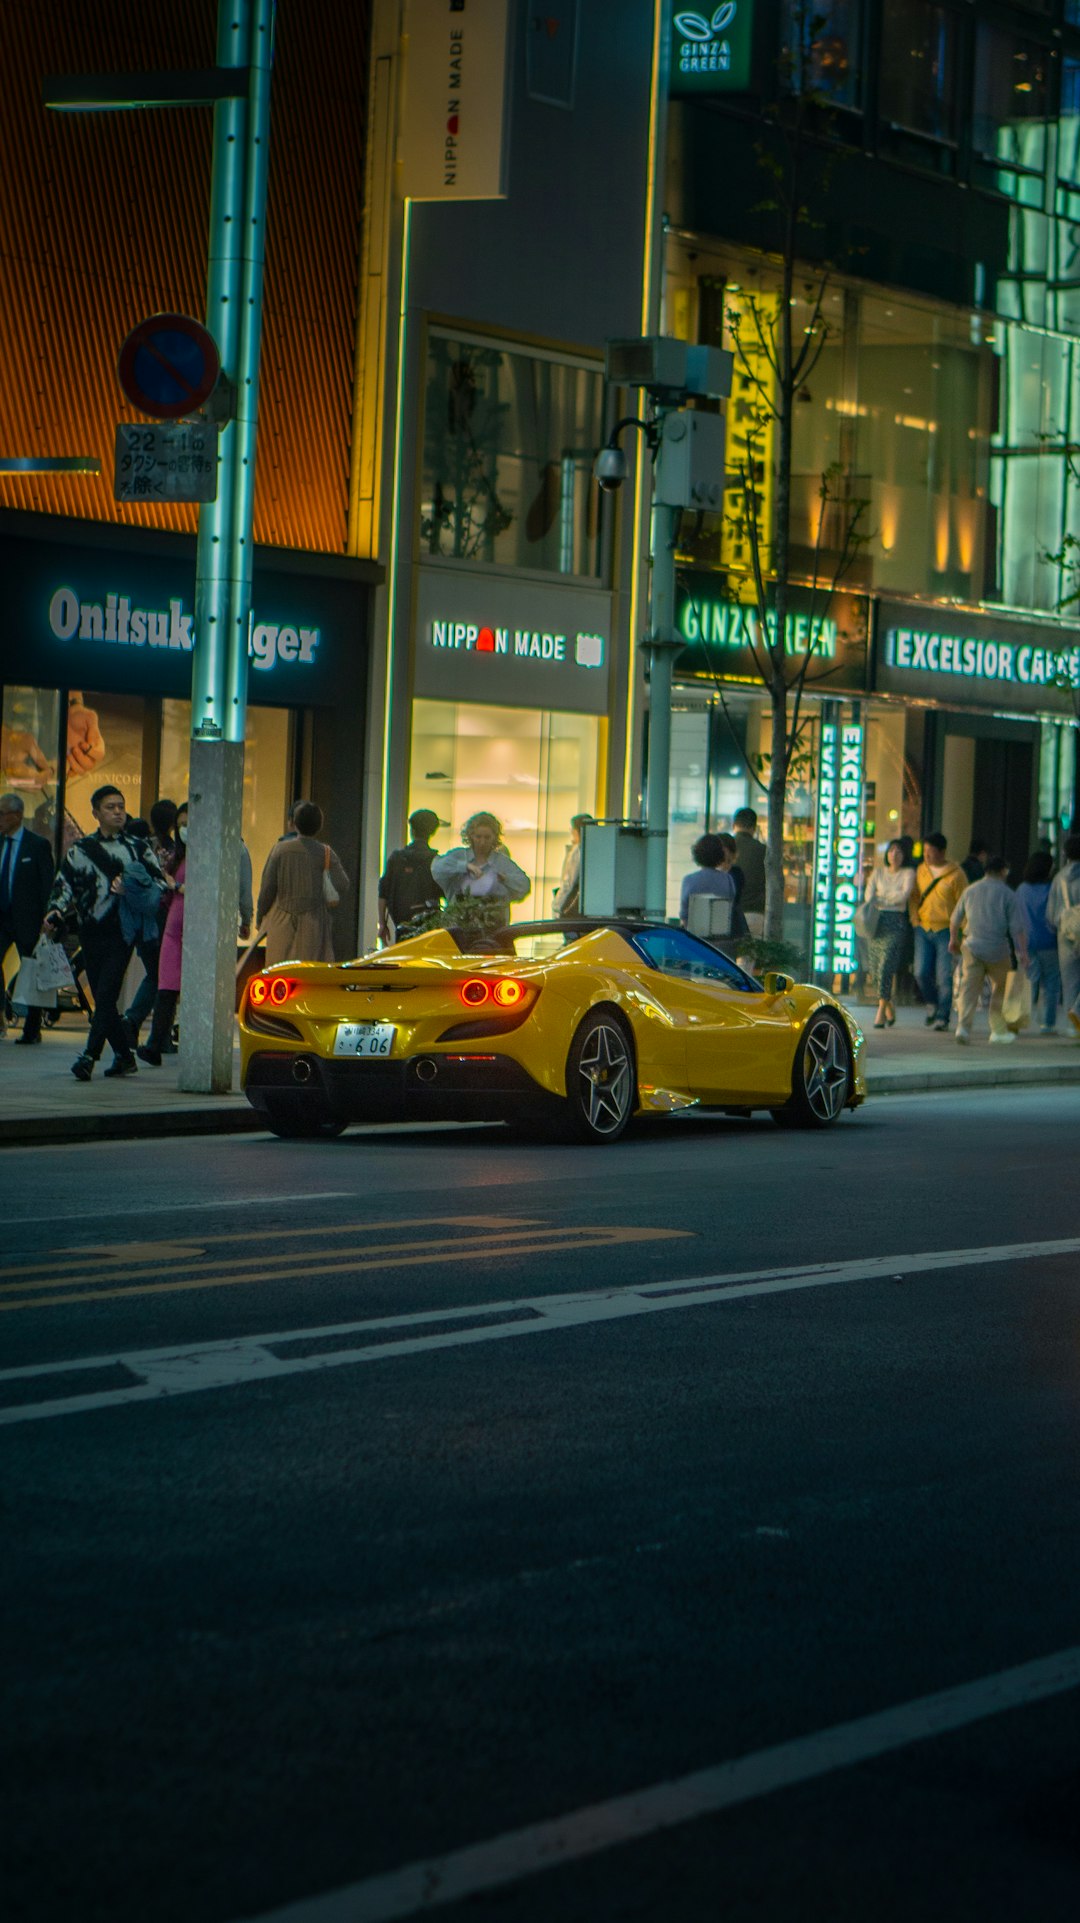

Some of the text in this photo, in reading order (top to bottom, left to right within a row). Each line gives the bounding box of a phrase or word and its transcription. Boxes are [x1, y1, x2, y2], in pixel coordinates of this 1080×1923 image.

[449, 29, 463, 89] MADE
[679, 56, 731, 73] GREEN
[680, 41, 731, 57] GINZA
[50, 586, 196, 652] Onitsuk
[683, 600, 758, 649] GINZA
[514, 630, 567, 661] MADE
[896, 628, 1014, 680] EXCELSIOR
[832, 724, 863, 974] EXCELSIOR CAFFÉ
